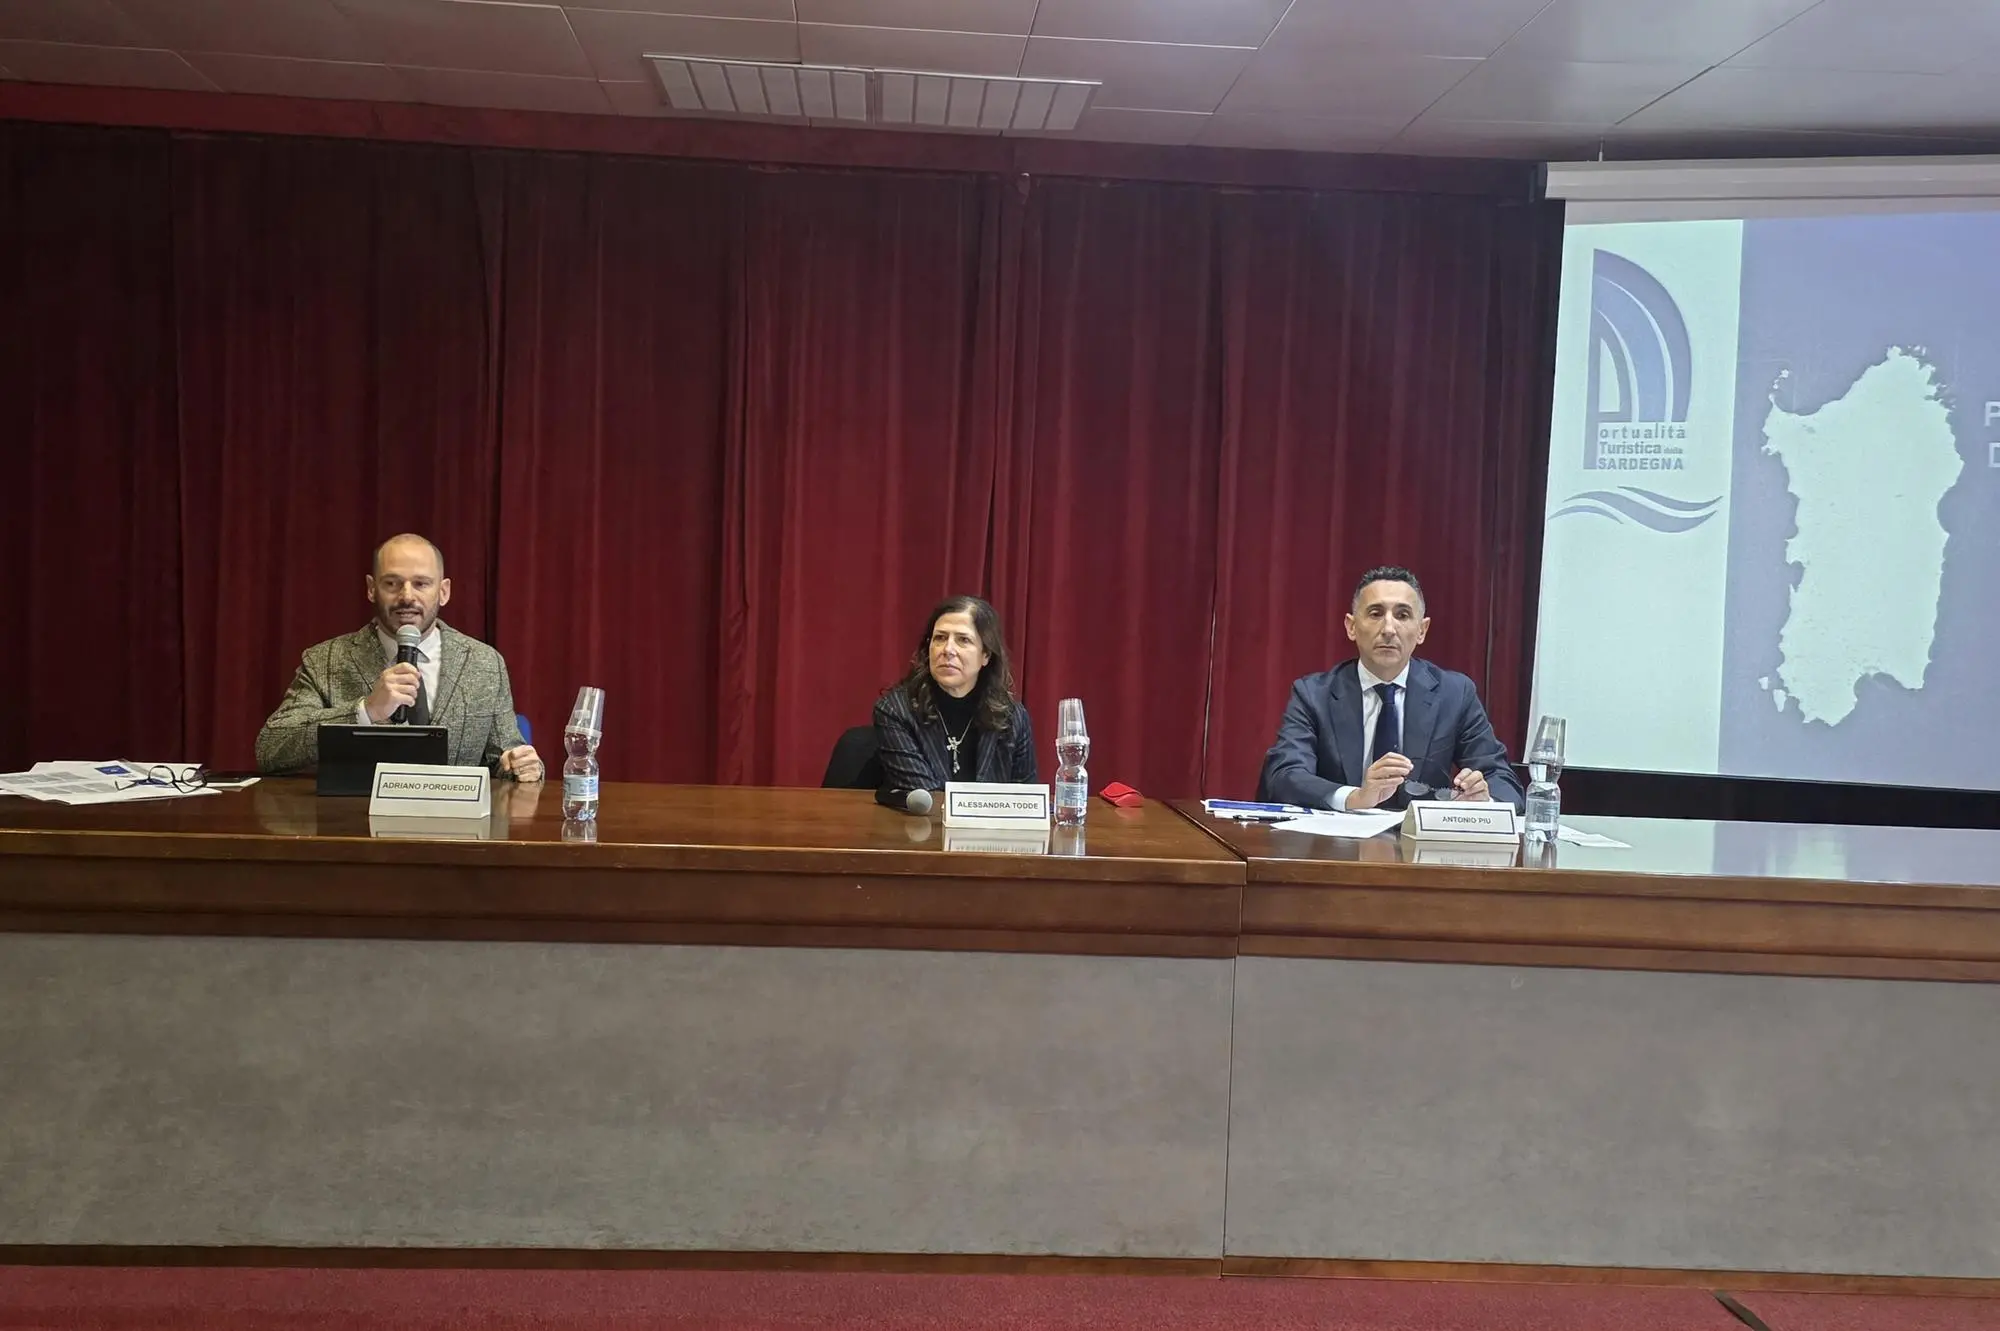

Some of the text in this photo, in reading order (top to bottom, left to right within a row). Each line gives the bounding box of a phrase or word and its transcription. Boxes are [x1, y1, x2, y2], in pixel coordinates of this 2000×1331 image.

[1599, 440, 1662, 455] Turistica
[1598, 457, 1684, 470] SARDEGNA
[382, 782, 477, 792] ADRIANO PORQUEDDU
[957, 801, 1039, 810] ALESSANDRA TODDE
[1442, 816, 1477, 824] ANTONIO
